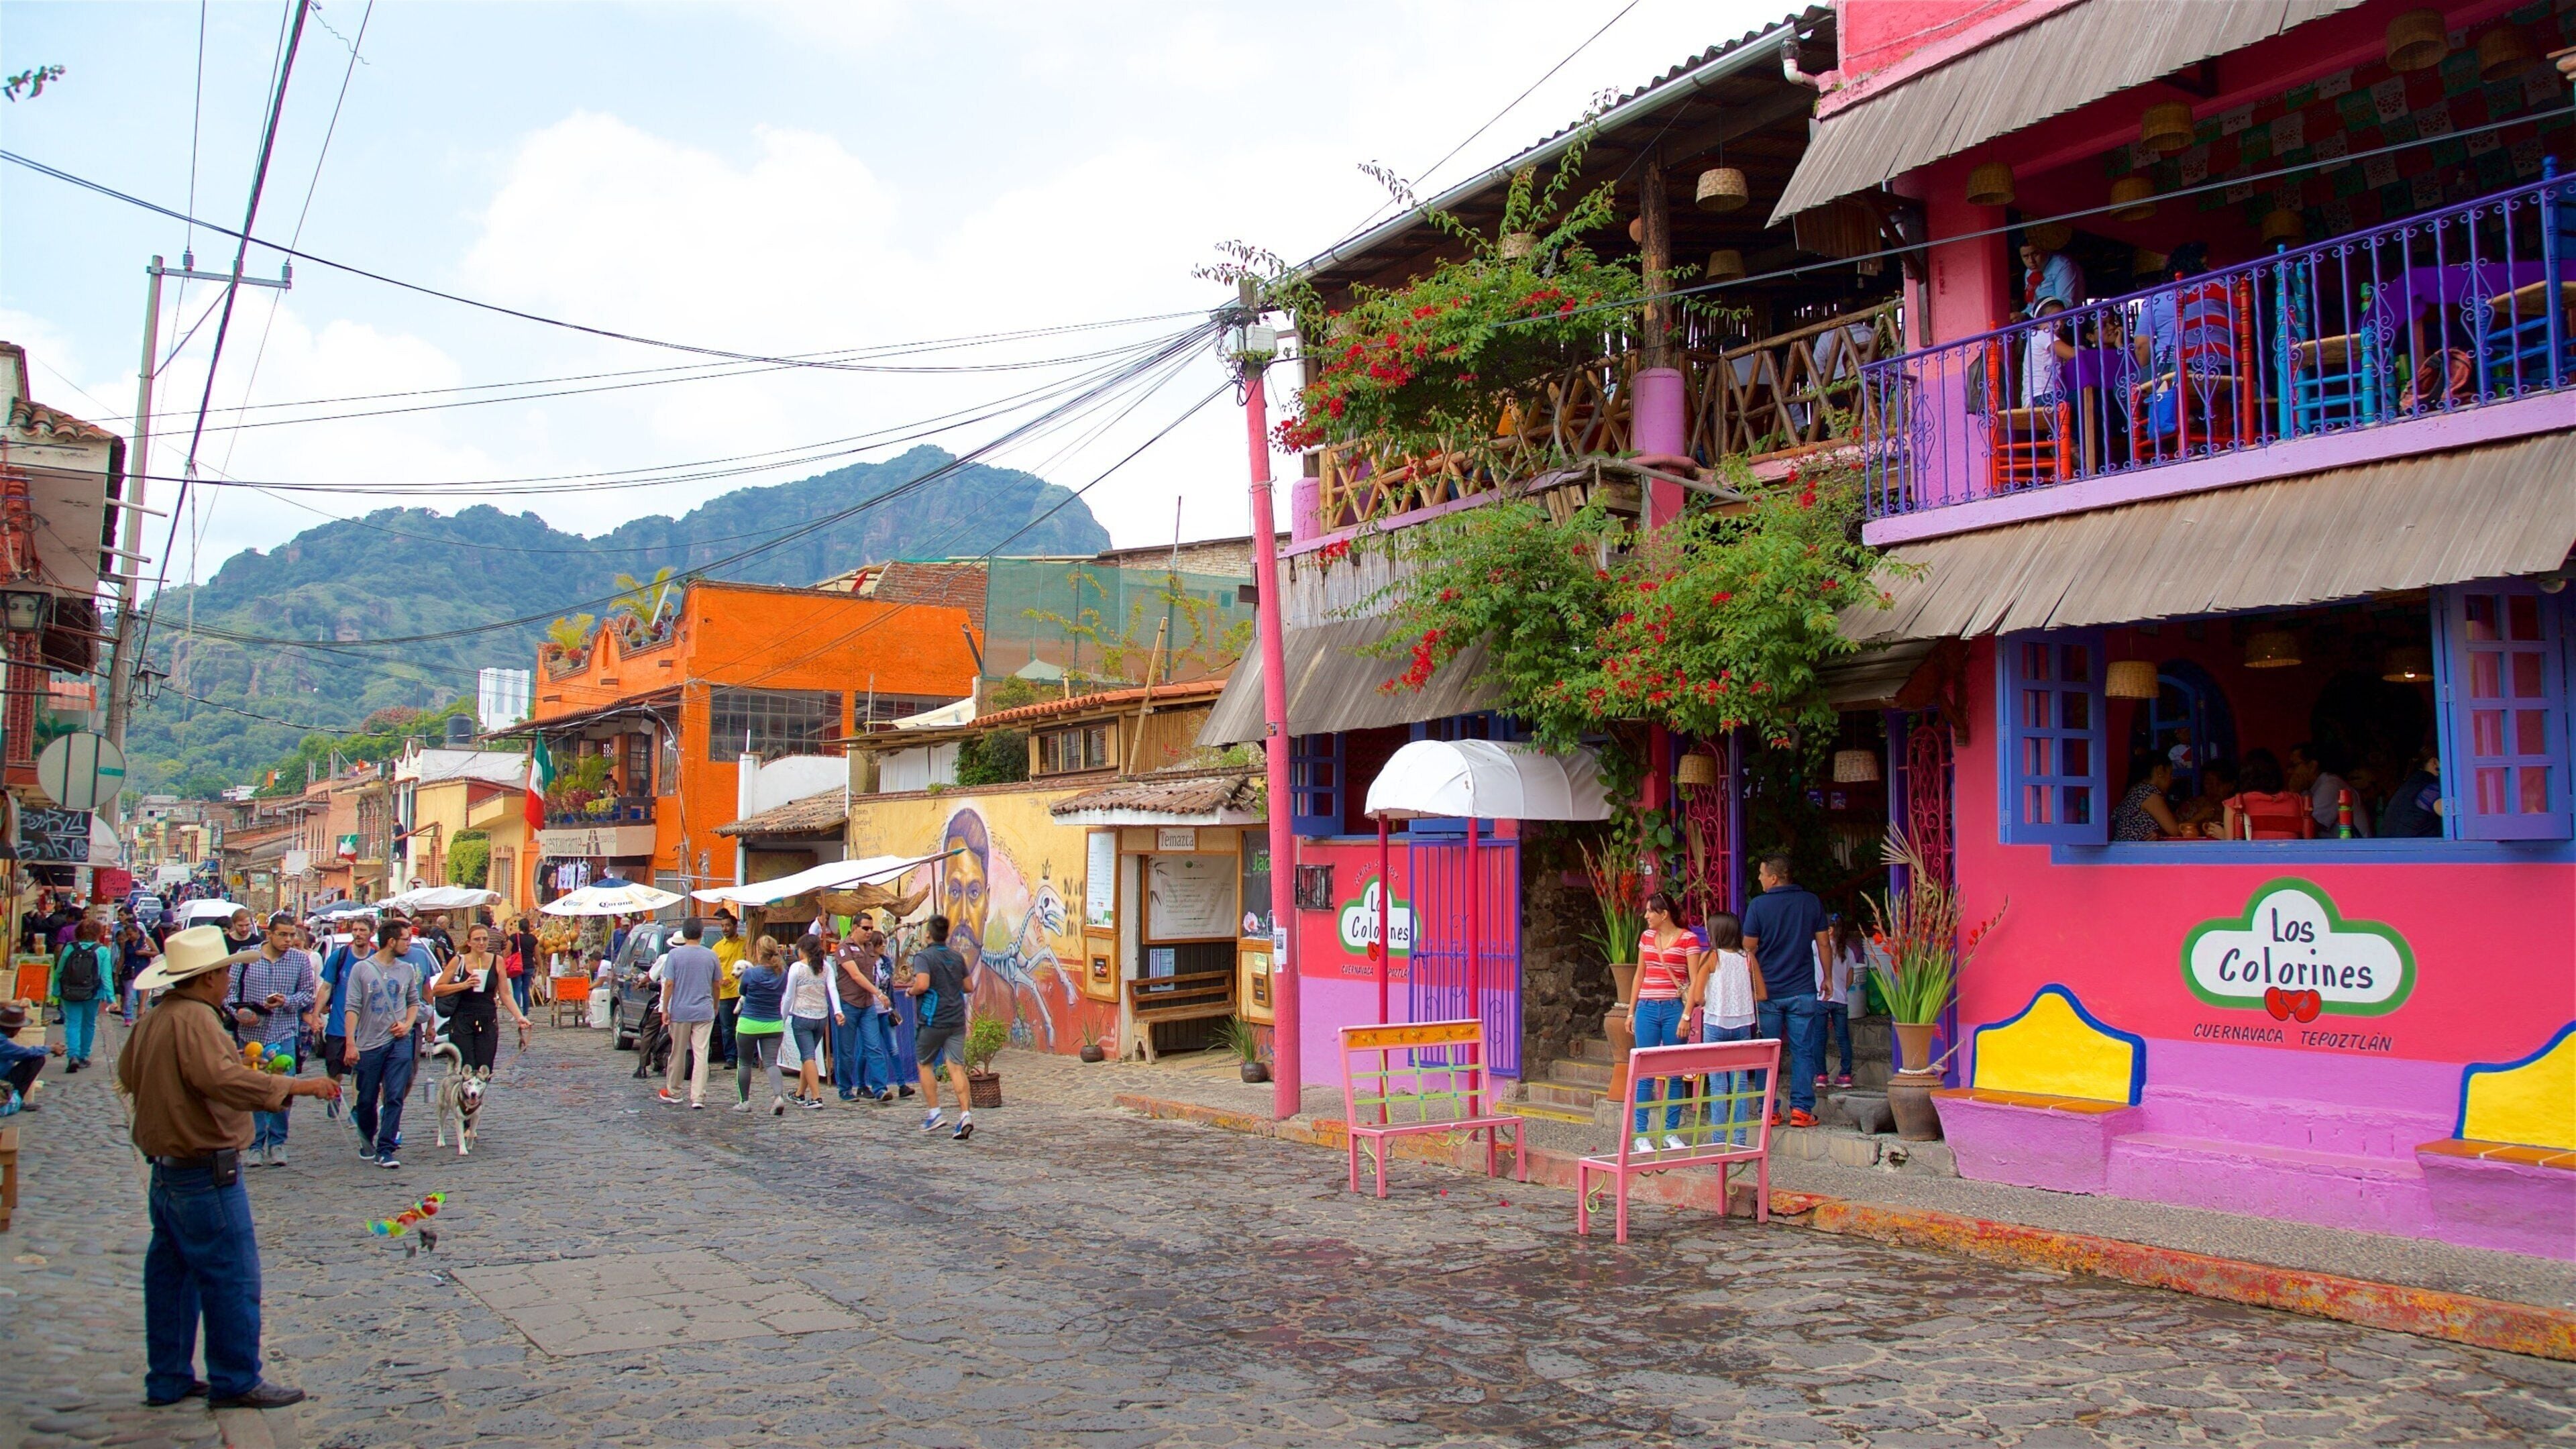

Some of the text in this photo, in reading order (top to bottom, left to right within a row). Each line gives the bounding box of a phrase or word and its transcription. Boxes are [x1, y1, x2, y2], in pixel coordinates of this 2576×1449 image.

[1352, 915, 1409, 941] Colones
[2271, 907, 2315, 943] Los
[1342, 965, 1374, 976] CUERNAVACA
[2218, 946, 2374, 989] Colorines
[2193, 1022, 2393, 1052] CUERNAVACA TEPOZTLÁN
